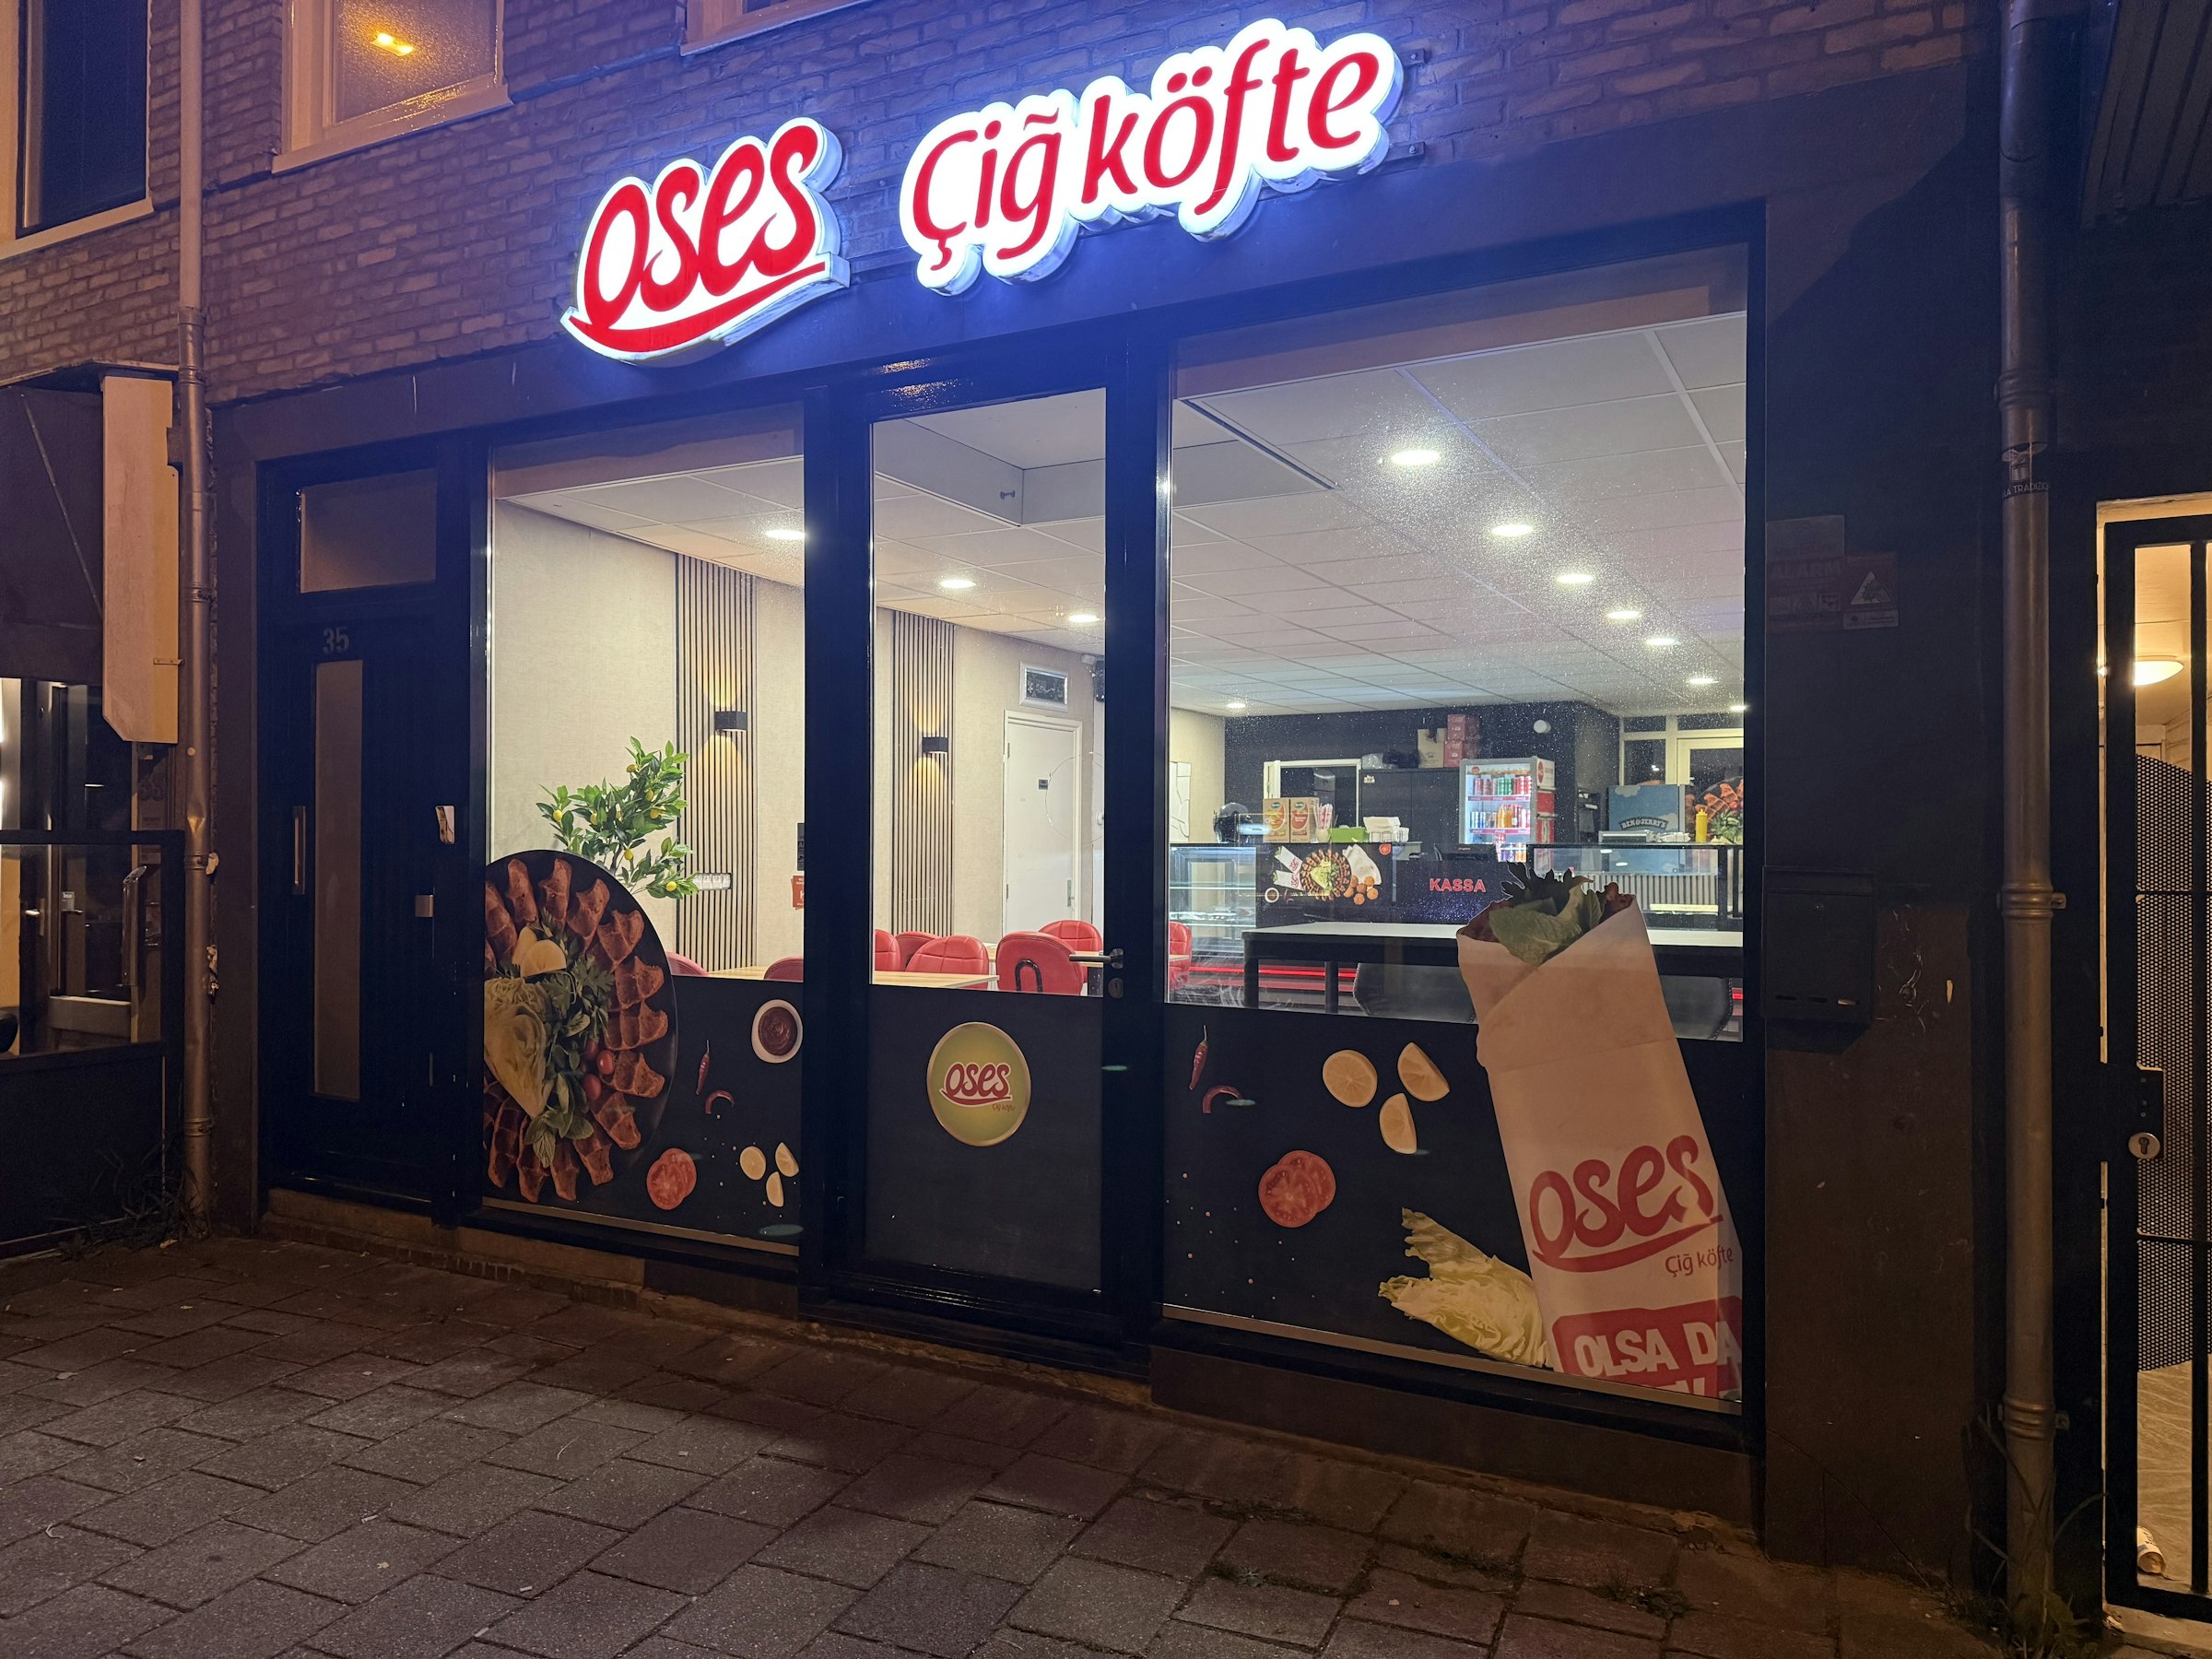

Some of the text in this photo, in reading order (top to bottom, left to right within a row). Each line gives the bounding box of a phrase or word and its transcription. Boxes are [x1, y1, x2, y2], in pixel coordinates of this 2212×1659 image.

[1080, 39, 1380, 215] köfte
[323, 627, 350, 654] 35
[1430, 878, 1486, 893] KASSA
[1697, 1245, 1734, 1270] köfte
[1574, 1328, 1679, 1377] OLSA
